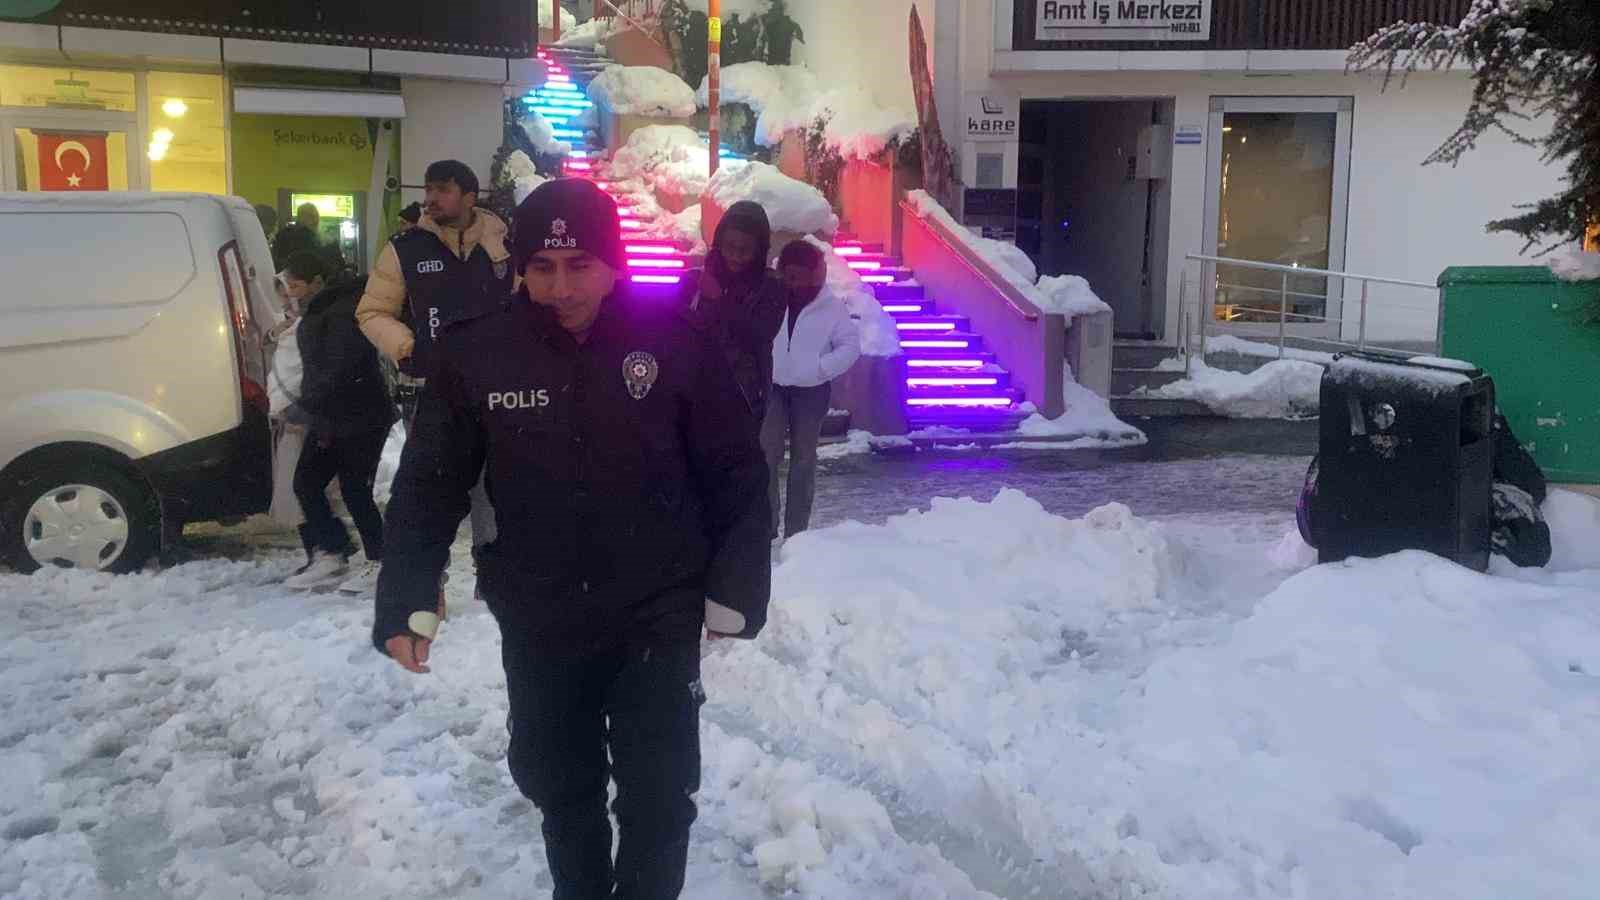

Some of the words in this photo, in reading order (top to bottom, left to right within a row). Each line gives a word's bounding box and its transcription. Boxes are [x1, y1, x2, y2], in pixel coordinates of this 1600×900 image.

[1118, 0, 1202, 20] Merkezi
[417, 260, 444, 273] GHD
[428, 307, 441, 338] POL
